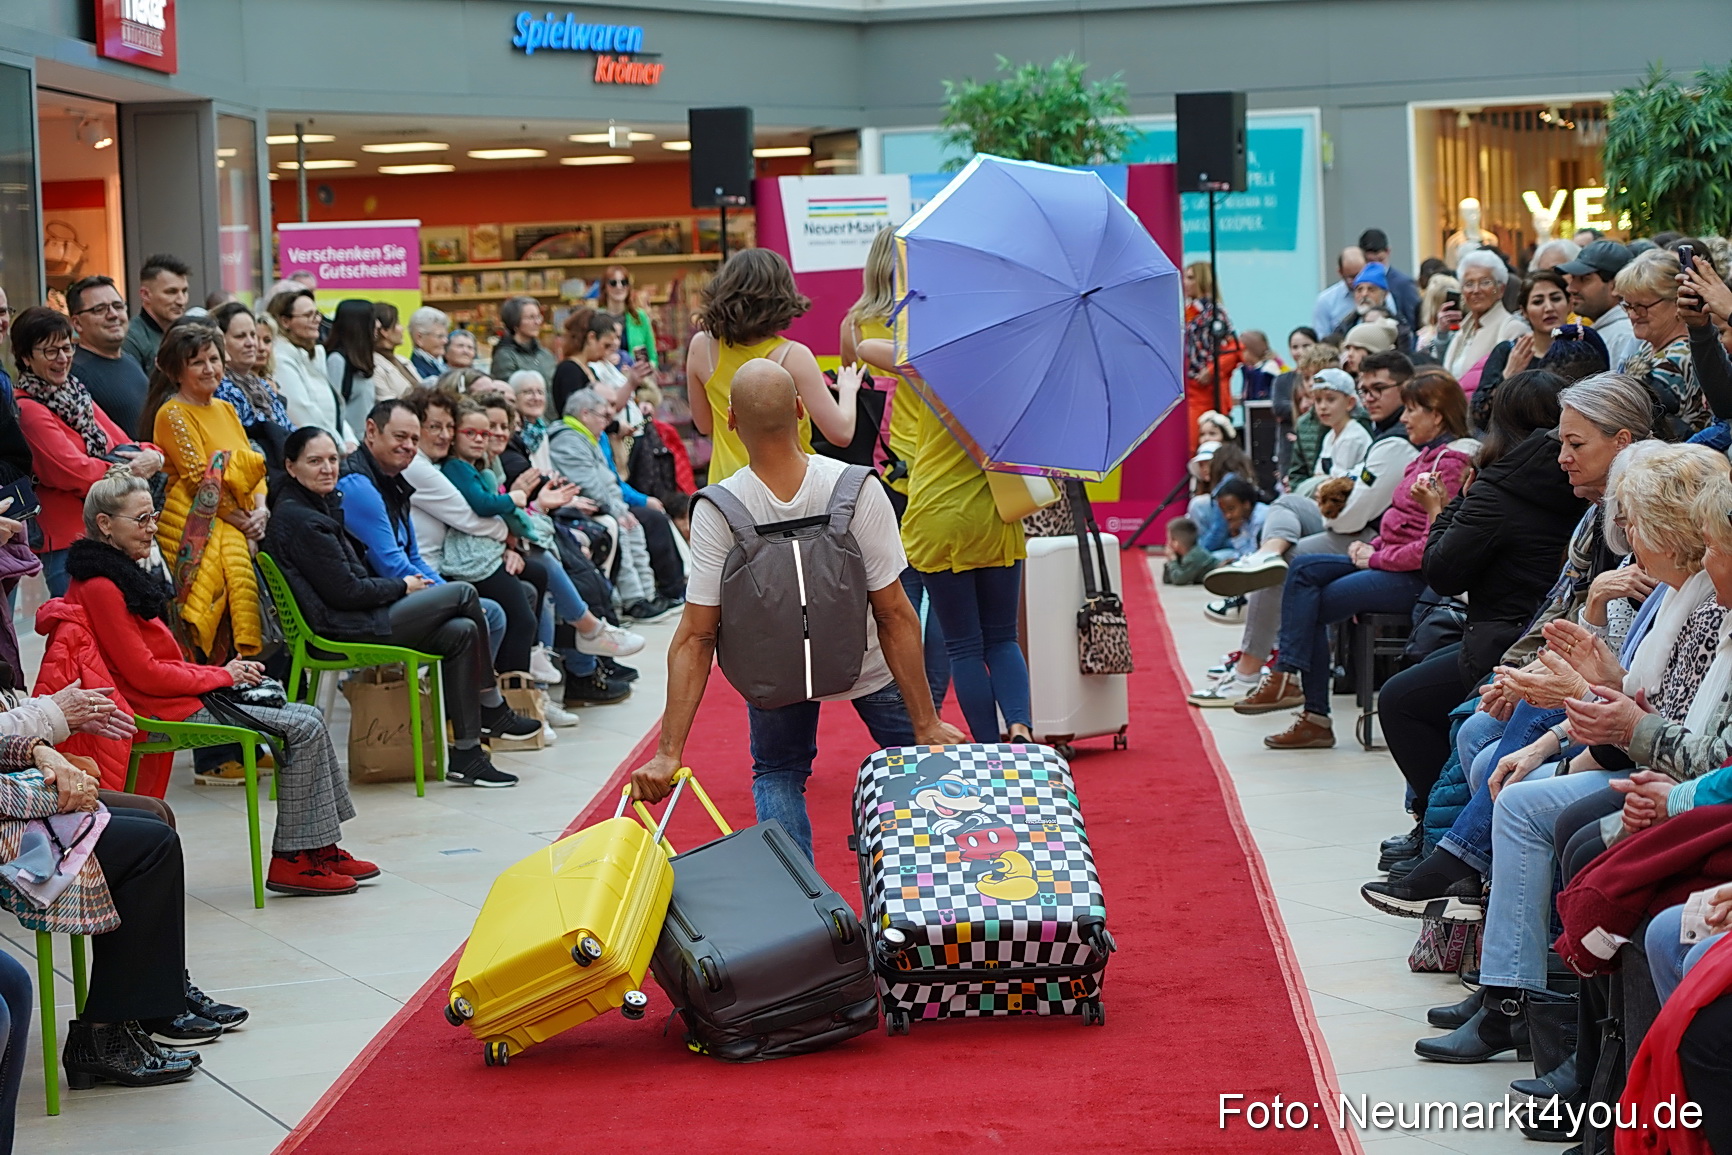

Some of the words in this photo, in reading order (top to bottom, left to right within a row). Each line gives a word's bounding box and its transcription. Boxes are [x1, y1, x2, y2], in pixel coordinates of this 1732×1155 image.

[513, 11, 645, 55] Spielwaren
[594, 54, 665, 85] Krömer
[287, 245, 382, 264] Verschenken
[382, 243, 407, 261] Sie
[319, 260, 408, 280] Gutscheine!
